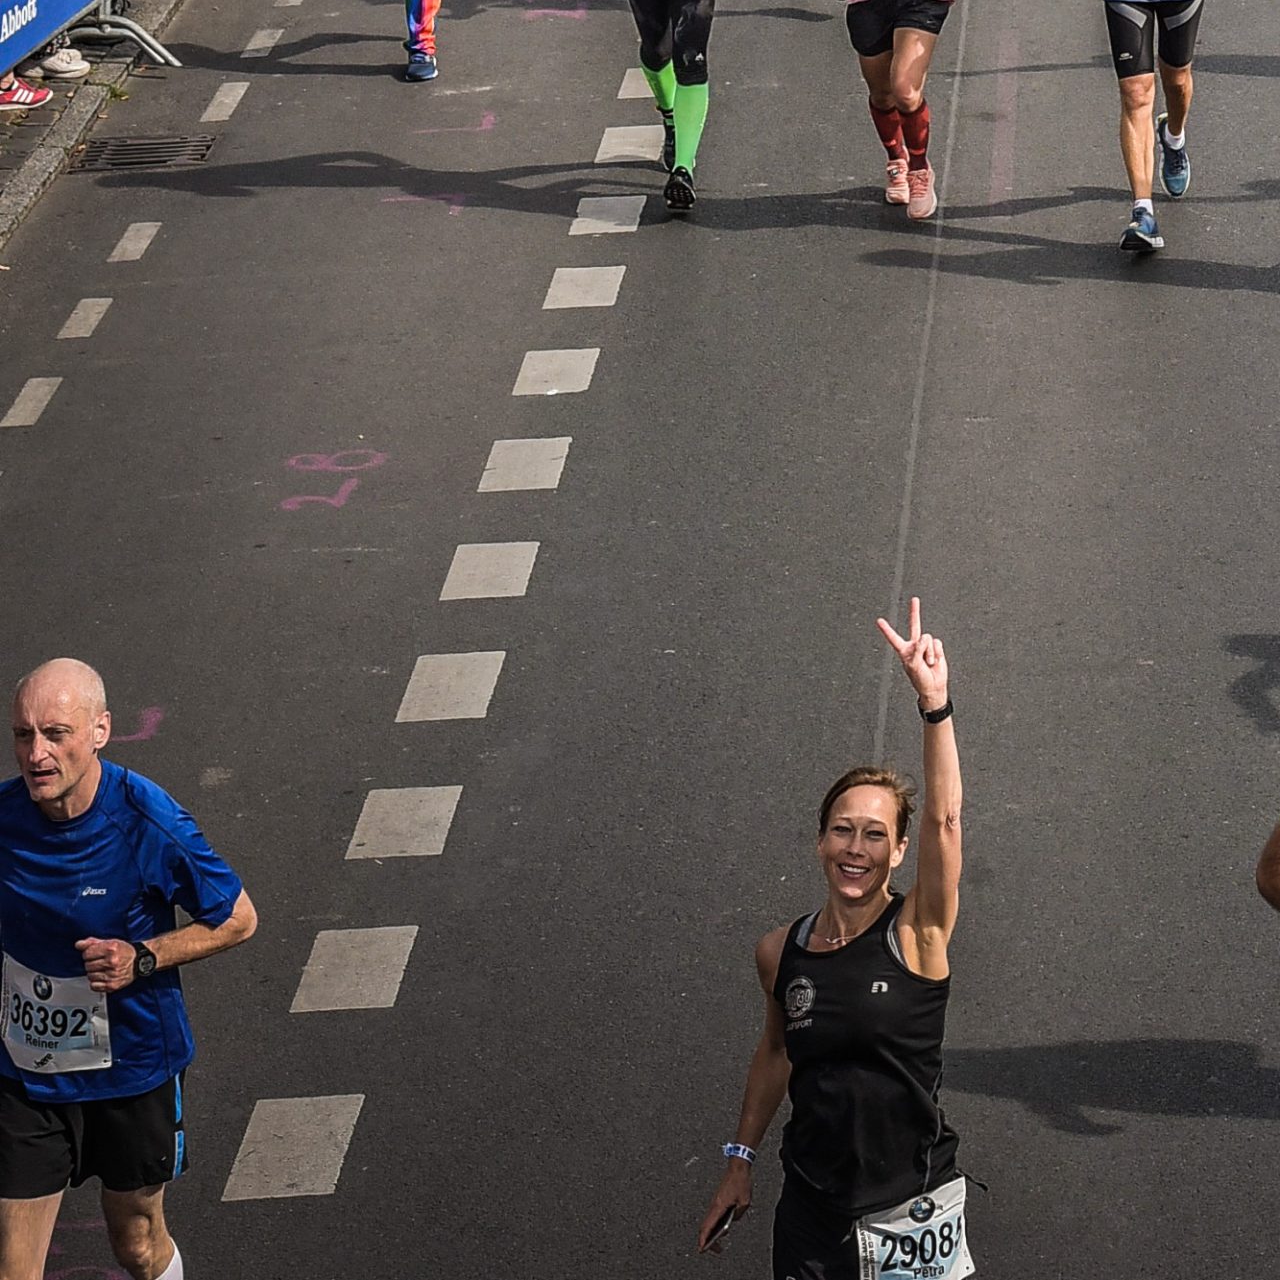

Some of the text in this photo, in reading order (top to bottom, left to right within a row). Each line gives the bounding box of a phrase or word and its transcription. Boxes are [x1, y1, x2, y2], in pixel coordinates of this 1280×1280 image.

[10, 992, 88, 1038] 36392
[25, 1033, 60, 1050] Reiner
[913, 1265, 946, 1280] Petra
